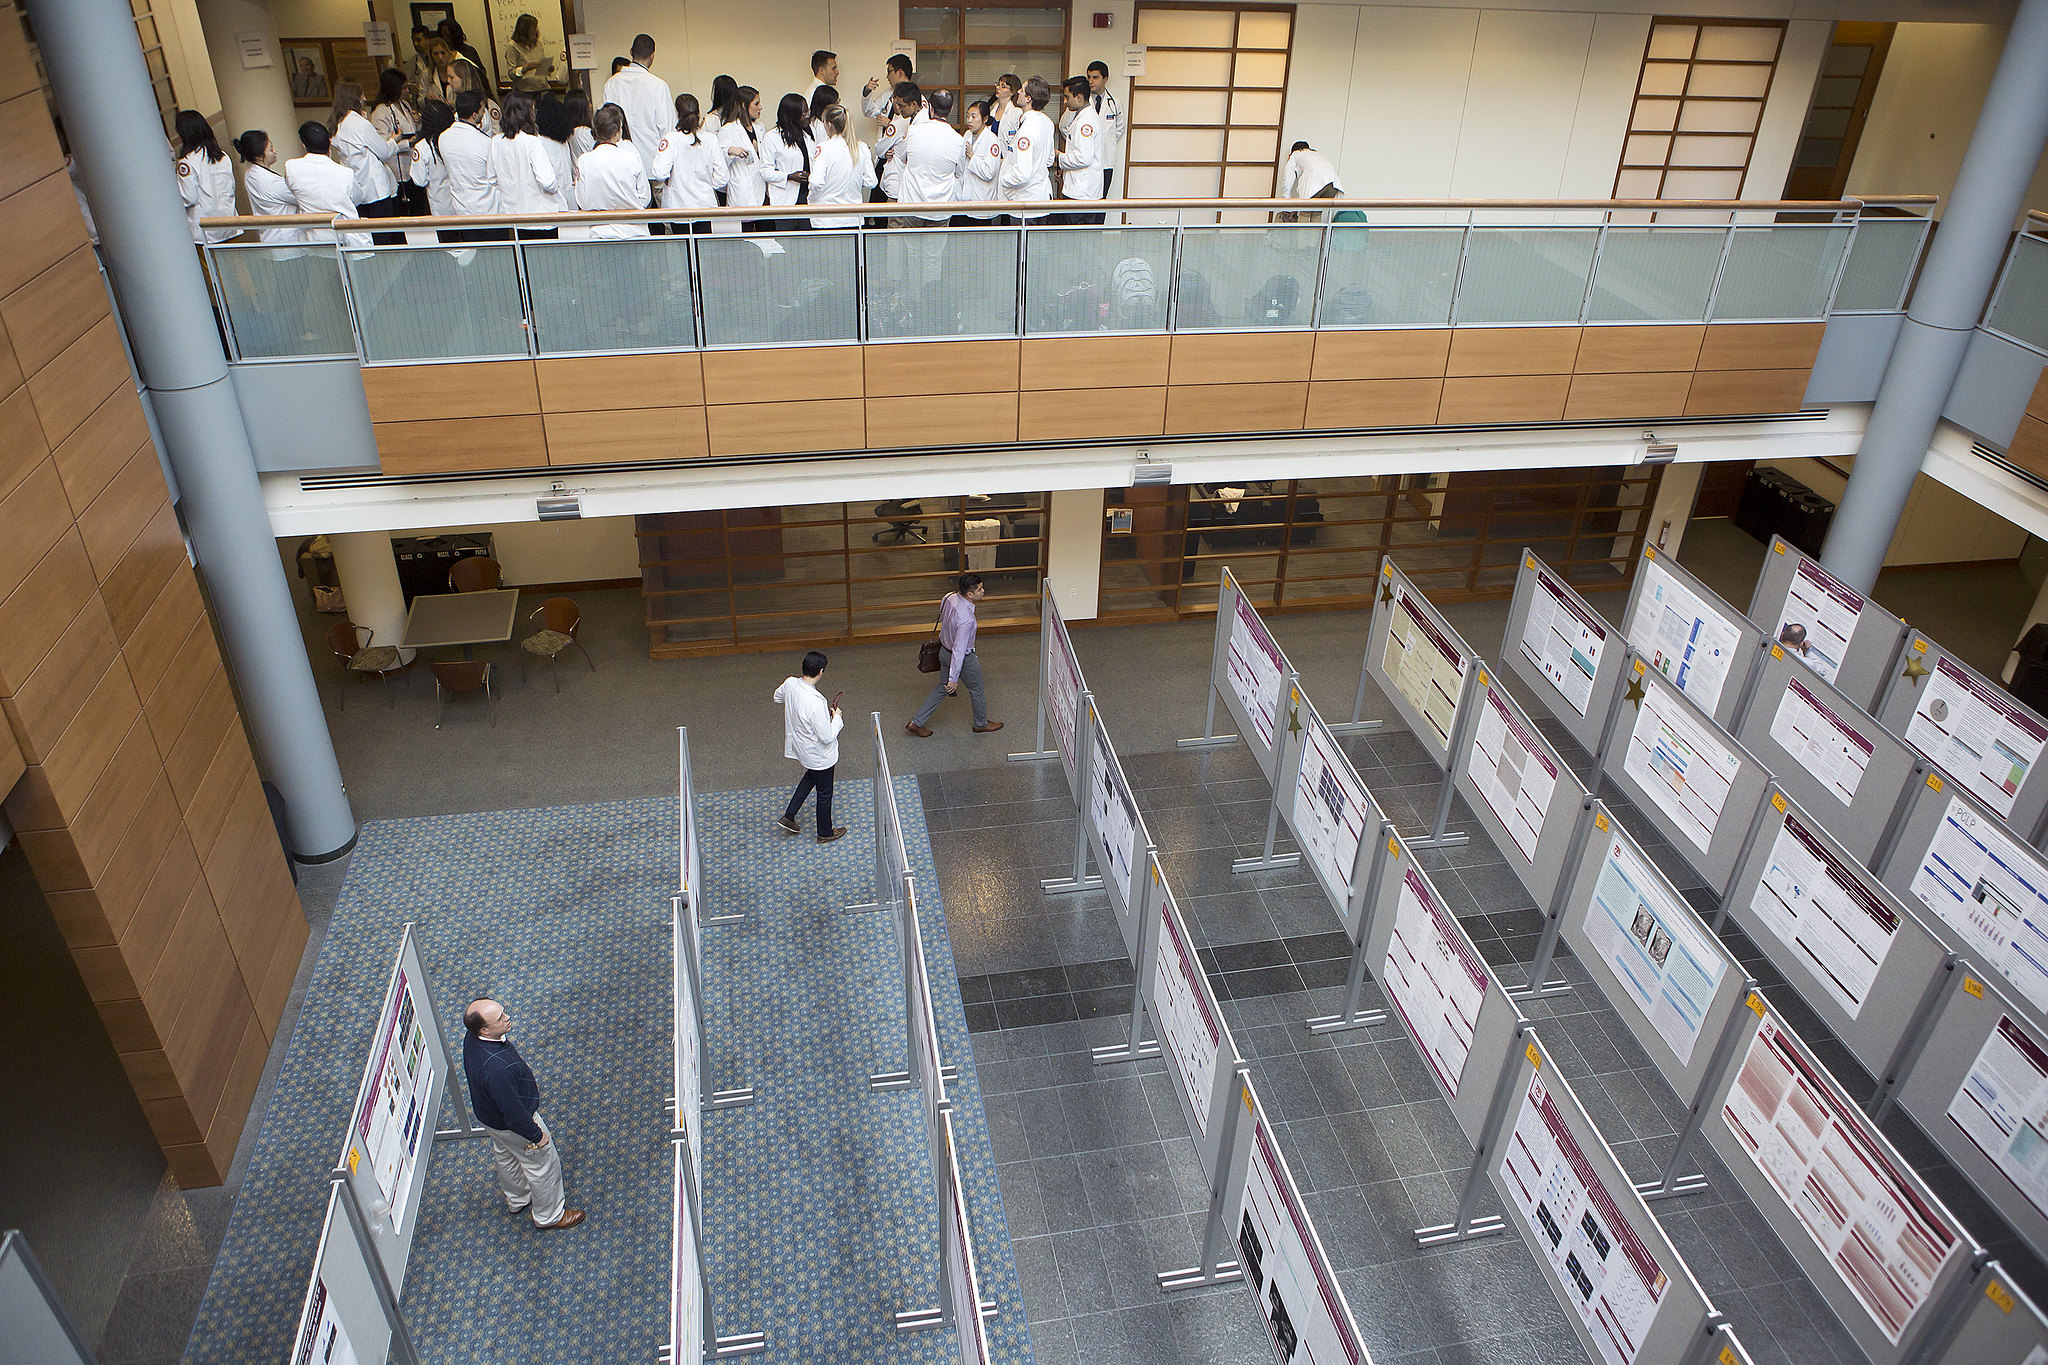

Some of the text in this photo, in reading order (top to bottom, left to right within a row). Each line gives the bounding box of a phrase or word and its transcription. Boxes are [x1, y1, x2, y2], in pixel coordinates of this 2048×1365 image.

[1929, 776, 1941, 790] 211
[1966, 980, 1982, 994] 194
[1749, 997, 1764, 1015] 178
